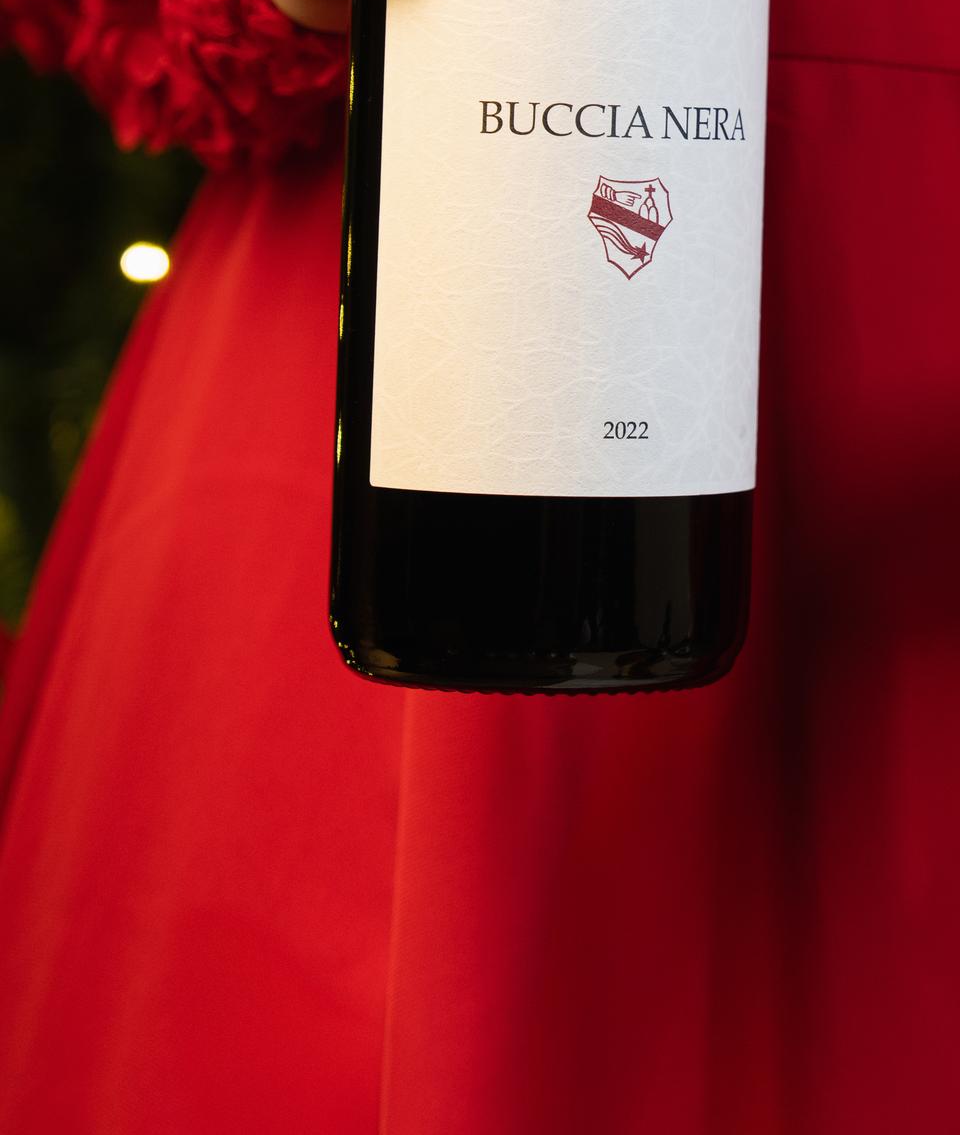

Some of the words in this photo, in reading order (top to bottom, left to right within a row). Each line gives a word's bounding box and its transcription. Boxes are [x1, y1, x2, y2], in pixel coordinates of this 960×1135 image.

[479, 100, 653, 139] BUCCIA
[661, 106, 746, 141] NERA
[603, 421, 648, 439] 2022
